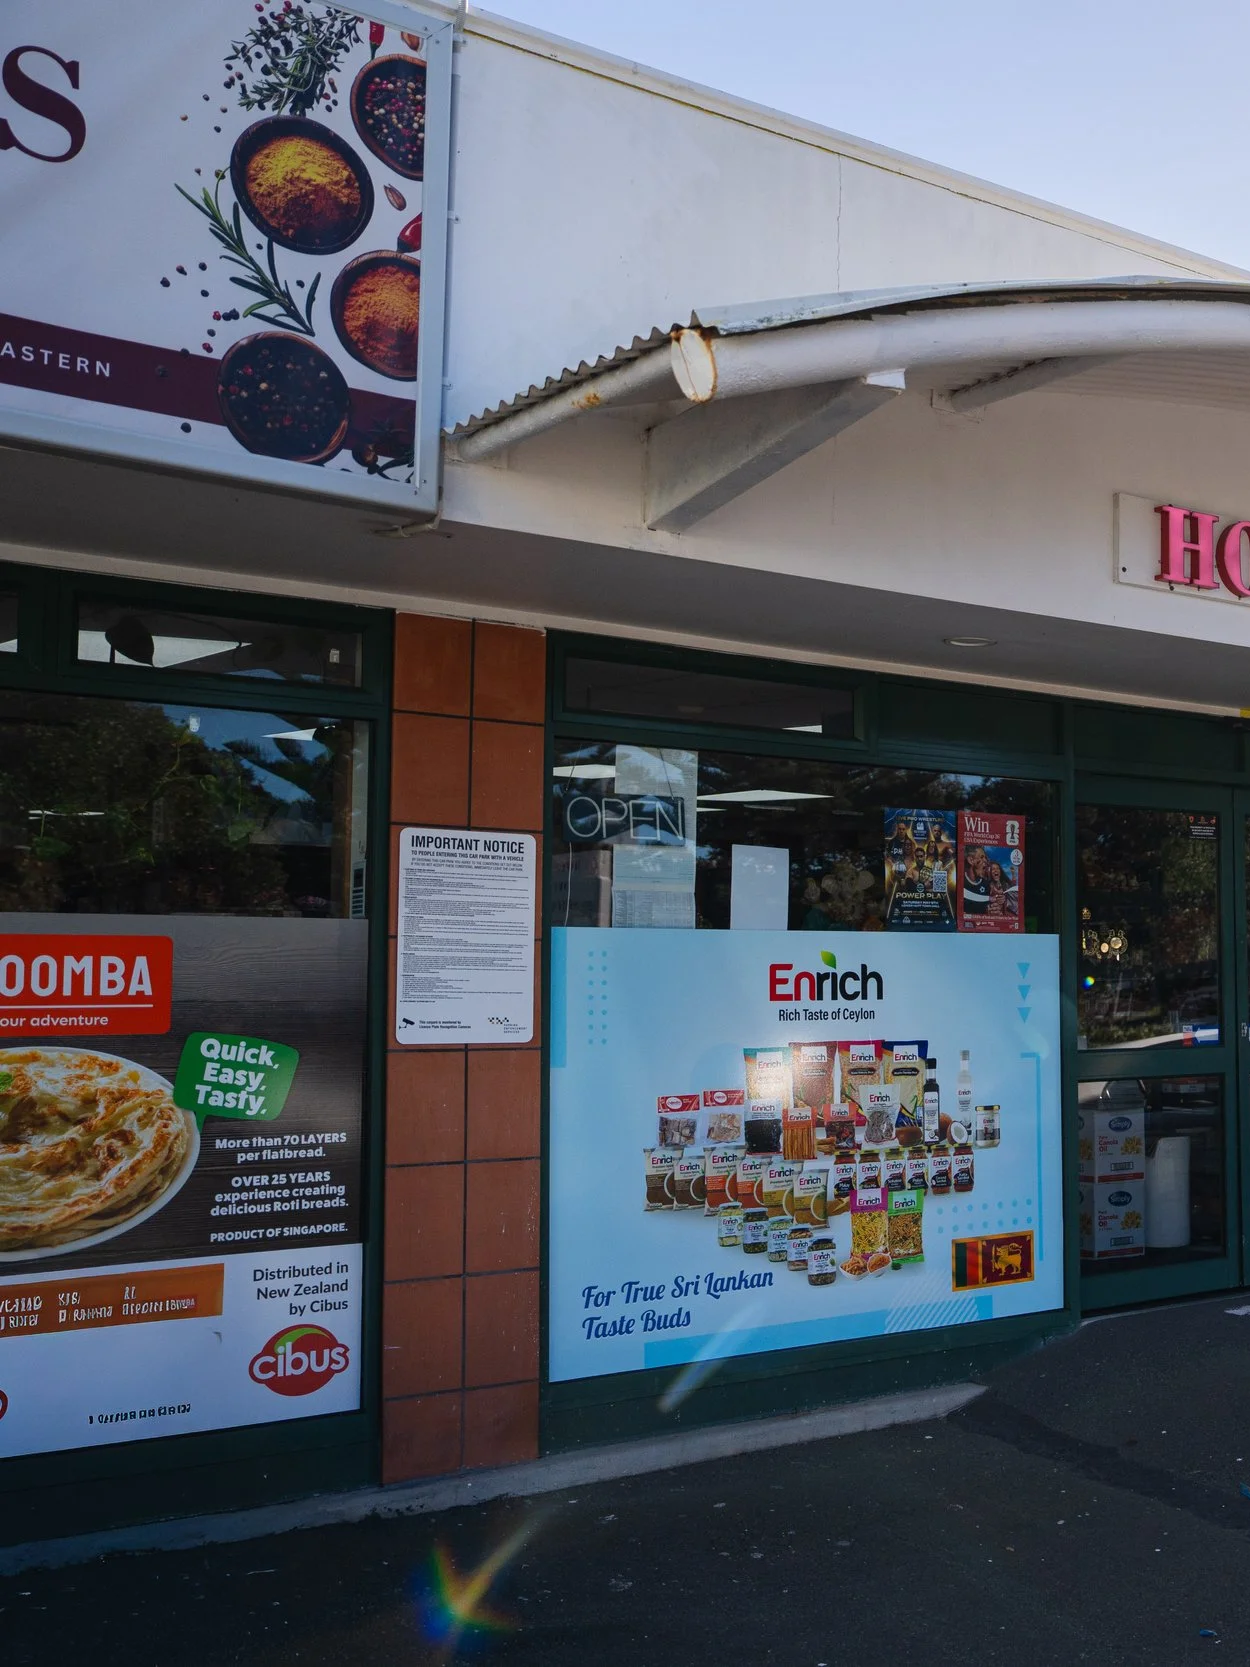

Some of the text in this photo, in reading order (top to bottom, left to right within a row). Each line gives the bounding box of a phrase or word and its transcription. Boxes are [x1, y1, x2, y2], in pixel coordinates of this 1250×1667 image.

[567, 796, 684, 842] OPEN
[964, 816, 989, 833] Win
[411, 835, 525, 854] IMPORTANT NOTICE
[0, 955, 153, 997] OOMBA
[769, 963, 884, 1001] Enrich
[30, 1014, 109, 1027] adventure
[779, 1008, 875, 1022] Rich Taste of Ceylon
[200, 1038, 281, 1070] Quick,
[801, 1052, 826, 1061] Enrich
[851, 1053, 874, 1061] Enrich
[895, 1052, 917, 1061] Enrich
[870, 1094, 890, 1102] Enrich
[215, 1133, 347, 1149] More than 70 LAYERS
[237, 1147, 326, 1164] per flatbread.
[712, 1153, 737, 1163] Enrich
[680, 1163, 700, 1171] Enrich
[836, 1166, 853, 1174] Enrich
[861, 1165, 878, 1173] Enrich
[909, 1161, 925, 1169] Enrich
[231, 1171, 331, 1187] OVER 25 YEARS
[799, 1176, 821, 1186] Enrich
[215, 1184, 346, 1203] experience creating
[858, 1197, 880, 1206] Enrich
[210, 1197, 349, 1216] delicious Roti breads.
[894, 1199, 915, 1209] Enrich
[210, 1223, 348, 1242] PRODUCT OF SINGAPORE.
[813, 1252, 830, 1261] Enrich
[253, 1261, 348, 1282] Distributed in
[257, 1279, 348, 1300] New Zealand
[582, 1270, 773, 1309] For True Sri Lankan
[289, 1299, 348, 1316] by Cibus
[582, 1307, 691, 1340] Taste Buds
[253, 1341, 346, 1380] cibus
